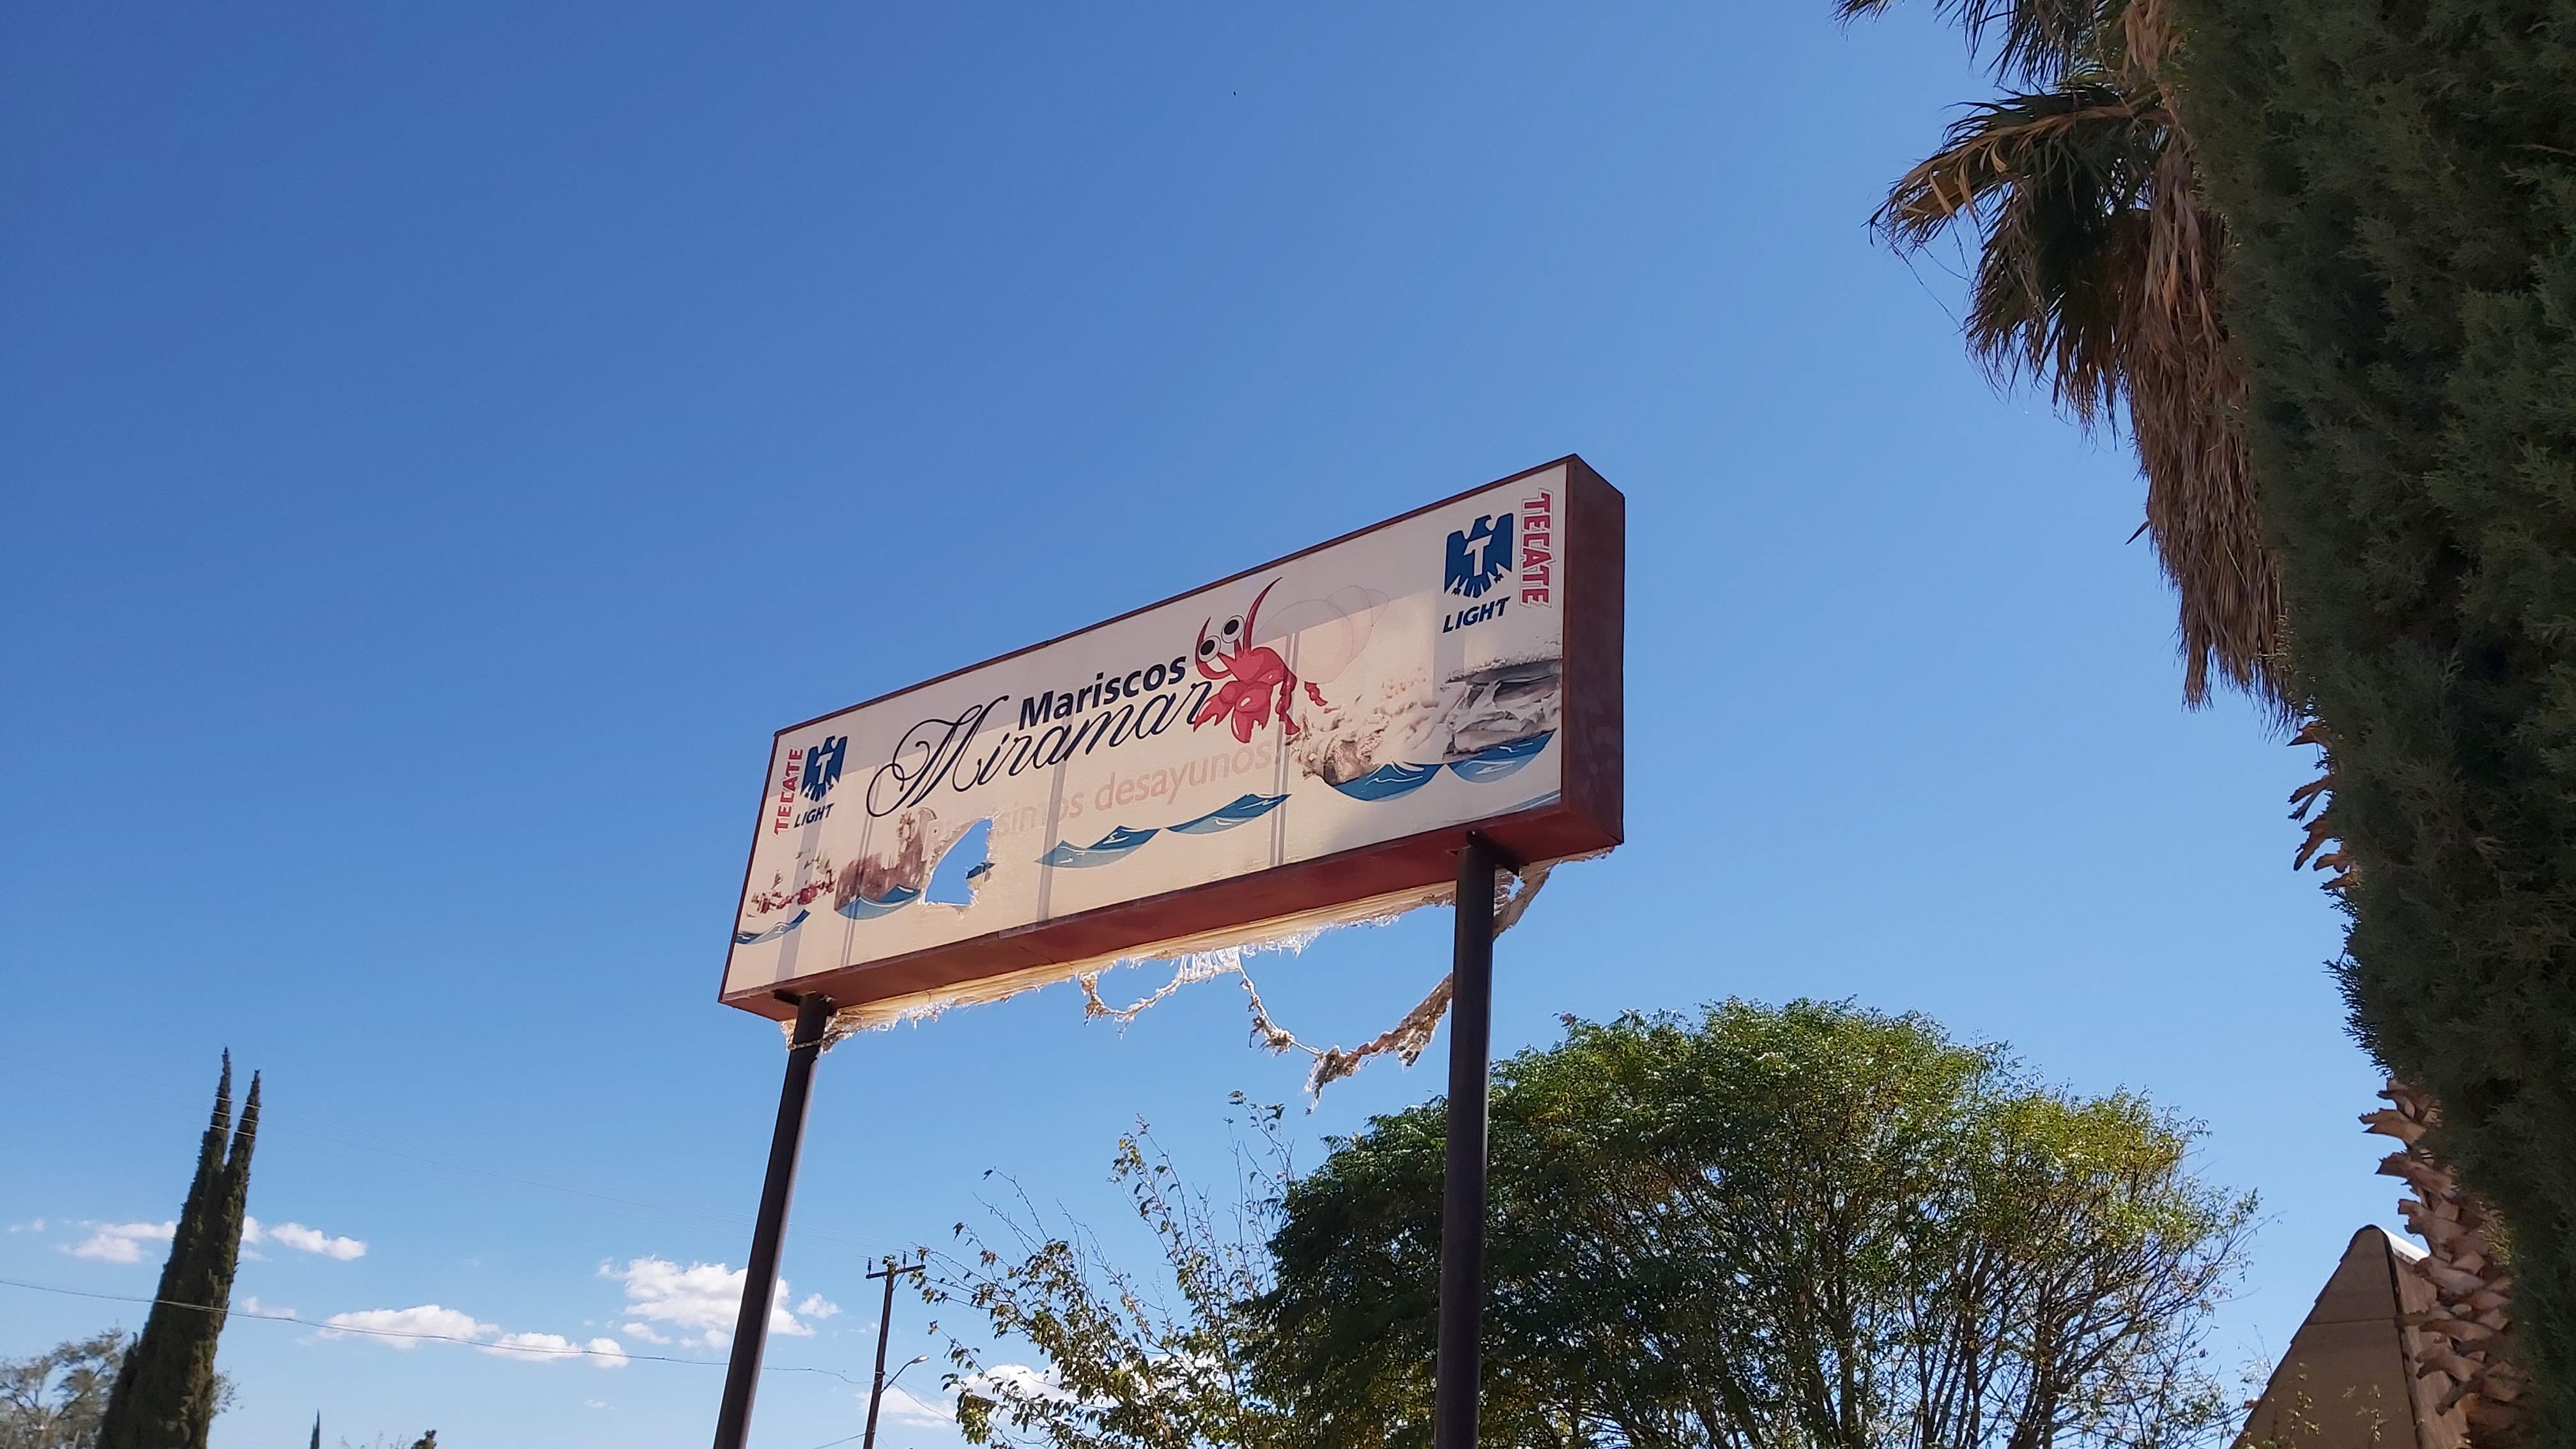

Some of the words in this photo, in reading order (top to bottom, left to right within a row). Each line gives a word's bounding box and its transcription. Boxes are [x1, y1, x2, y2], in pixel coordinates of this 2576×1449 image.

[1521, 491, 1553, 605] TECATE
[1442, 595, 1511, 634] LIGHT
[1018, 656, 1187, 732] Mariscos
[866, 681, 1213, 817] Miramar
[774, 749, 804, 836] TECATE
[793, 802, 835, 829] LIGHT
